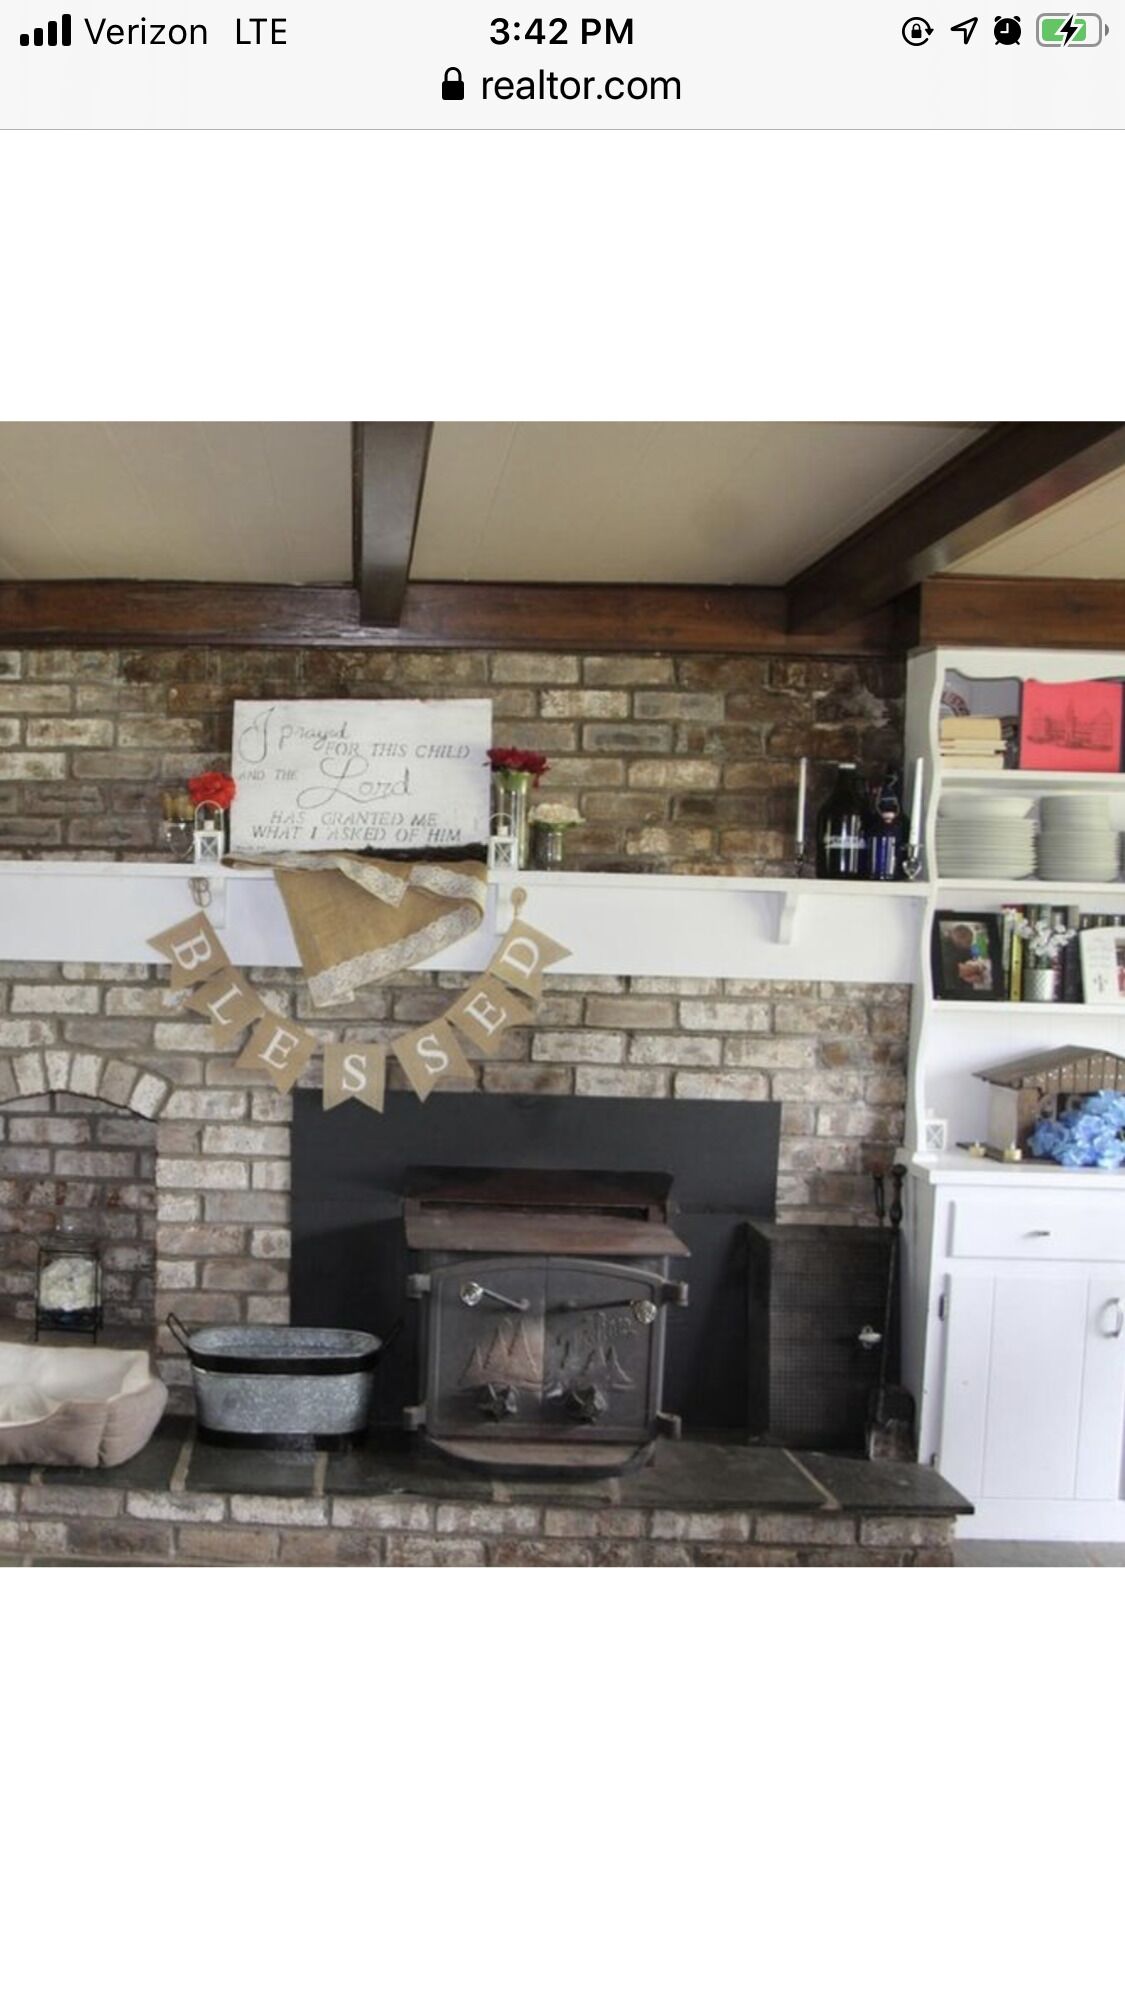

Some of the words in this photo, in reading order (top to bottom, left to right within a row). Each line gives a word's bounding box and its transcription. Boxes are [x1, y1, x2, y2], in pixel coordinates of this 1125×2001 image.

[84, 17, 207, 45] Verizon
[237, 18, 287, 44] LTE
[490, 18, 567, 45] 3:42
[582, 18, 633, 44] PM
[482, 69, 681, 100] realtor.com
[325, 742, 360, 758] FOR
[371, 742, 408, 759] THIS
[415, 744, 471, 760] CHILD
[296, 755, 413, 810] Lord
[270, 810, 306, 825] HAS
[321, 811, 404, 826] GRANTED
[410, 813, 440, 827] ME
[251, 825, 304, 840] WHAT
[309, 826, 318, 840] I
[327, 826, 387, 841] ASKED
[395, 829, 420, 842] OF
[427, 828, 463, 843] HIM
[170, 929, 541, 1095] BLESSED
